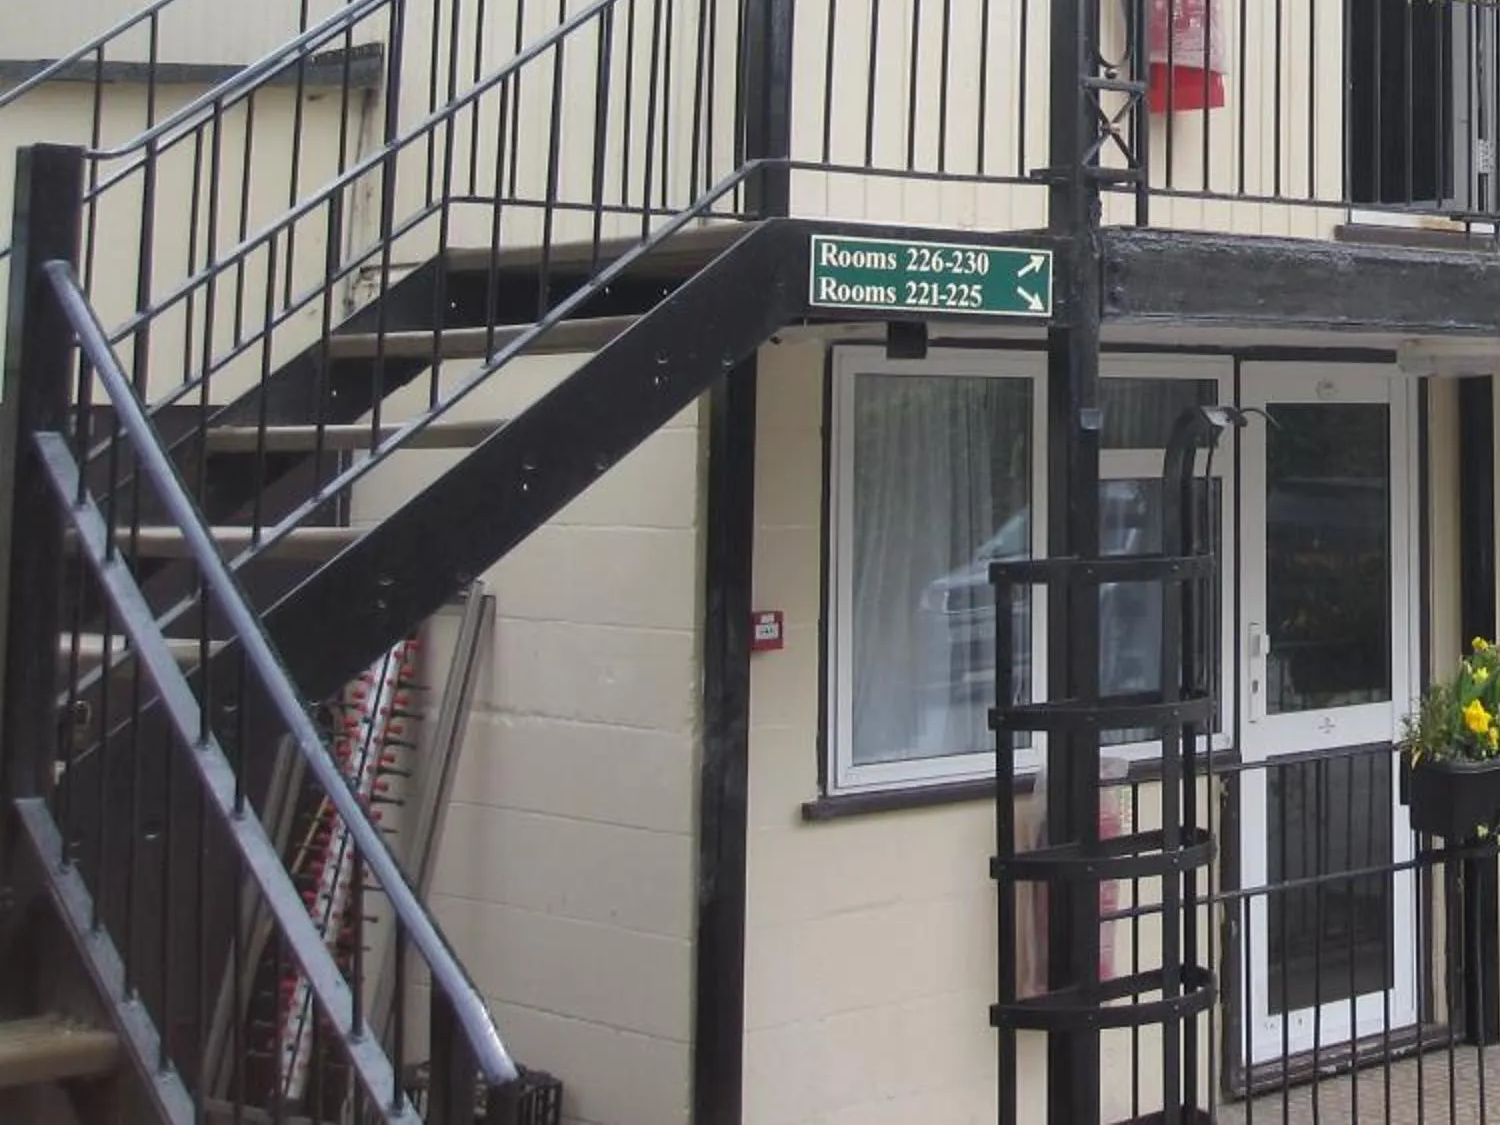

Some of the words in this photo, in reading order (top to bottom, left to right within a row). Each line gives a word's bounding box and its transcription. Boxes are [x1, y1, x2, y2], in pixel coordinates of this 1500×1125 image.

[820, 242, 897, 270] Rooms
[906, 248, 989, 275] 226-230
[819, 276, 897, 304] Rooms
[905, 282, 982, 307] 221-225
